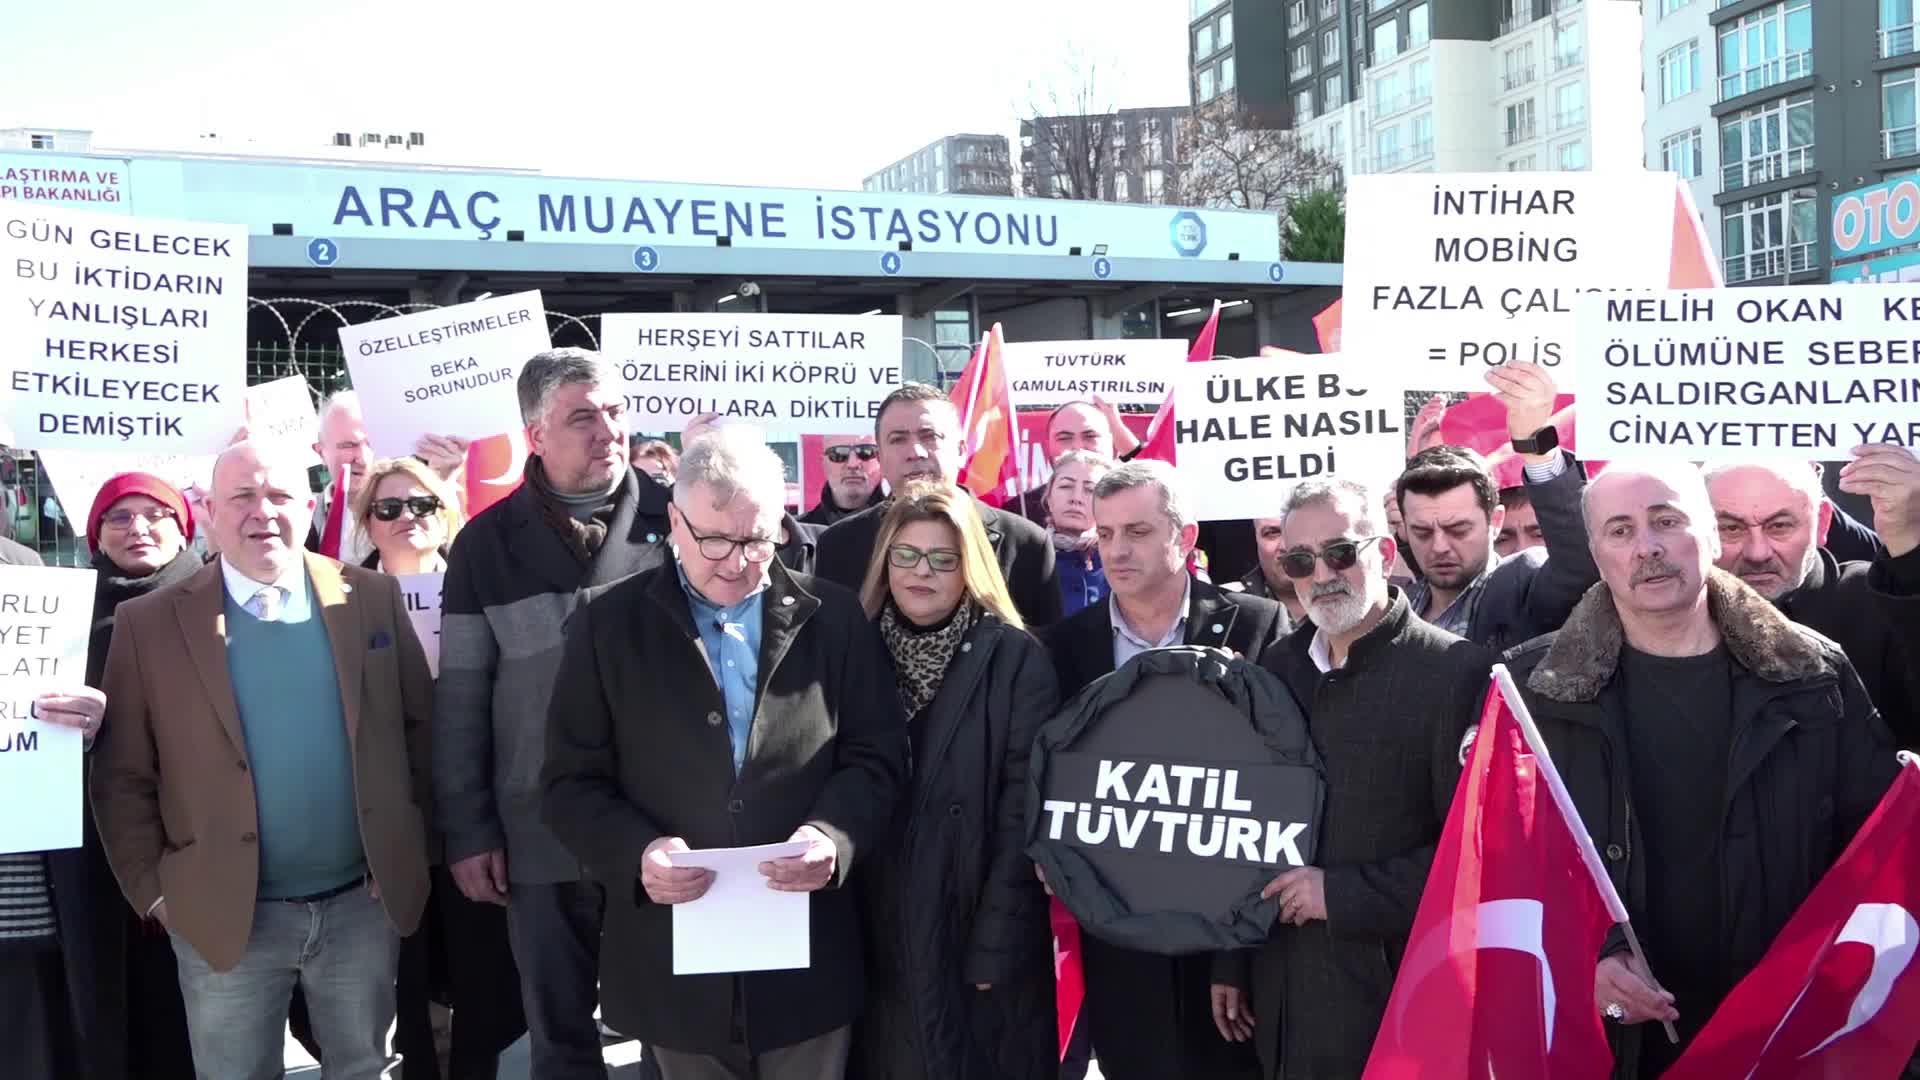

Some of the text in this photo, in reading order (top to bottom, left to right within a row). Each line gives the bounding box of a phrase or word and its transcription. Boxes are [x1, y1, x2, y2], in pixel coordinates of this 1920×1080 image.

[0, 167, 119, 185] AŞTIRMA VE
[23, 186, 120, 203] BAKANLIĞI
[1433, 184, 1575, 215] İNTİHAR
[333, 185, 1058, 247] ARAÇ MUAYENE İSTASYONU
[7, 218, 231, 257] GÜN GELECEK
[1435, 231, 1578, 262] MOBİNG
[16, 258, 223, 295] BU İKTİDARIN
[1373, 285, 1484, 310] FAZLA
[1607, 293, 1713, 322] MELİH
[1737, 298, 1843, 323] OKAN
[28, 297, 208, 330] YANLIŞLARI
[359, 309, 531, 357] ÖZELLEŞTİRMELER
[638, 325, 865, 351] HERŞEYİ SATTILAR
[46, 338, 179, 364] HERKESİ
[431, 356, 479, 377] BEKA
[1044, 352, 1126, 367] TÜVTÜRK
[1604, 336, 1784, 367] ÖLÜMÜNE
[12, 370, 220, 403] ETKİLEYECEK
[404, 367, 514, 403] SORUNUDUR
[614, 360, 899, 385] ÖZLERİNİ İKİ KÖPRÜ VE
[1206, 374, 1368, 404] ÜLKE B
[39, 411, 183, 441] DEMİŞTİK
[1176, 409, 1399, 444] HALE NASIL
[1609, 414, 1837, 447] CİNAYETTEN
[1224, 446, 1335, 482] GELDİ
[1, 594, 59, 615] RLU
[1095, 759, 1252, 812] KATİL
[1043, 799, 1308, 866] TÜVTÜRK
